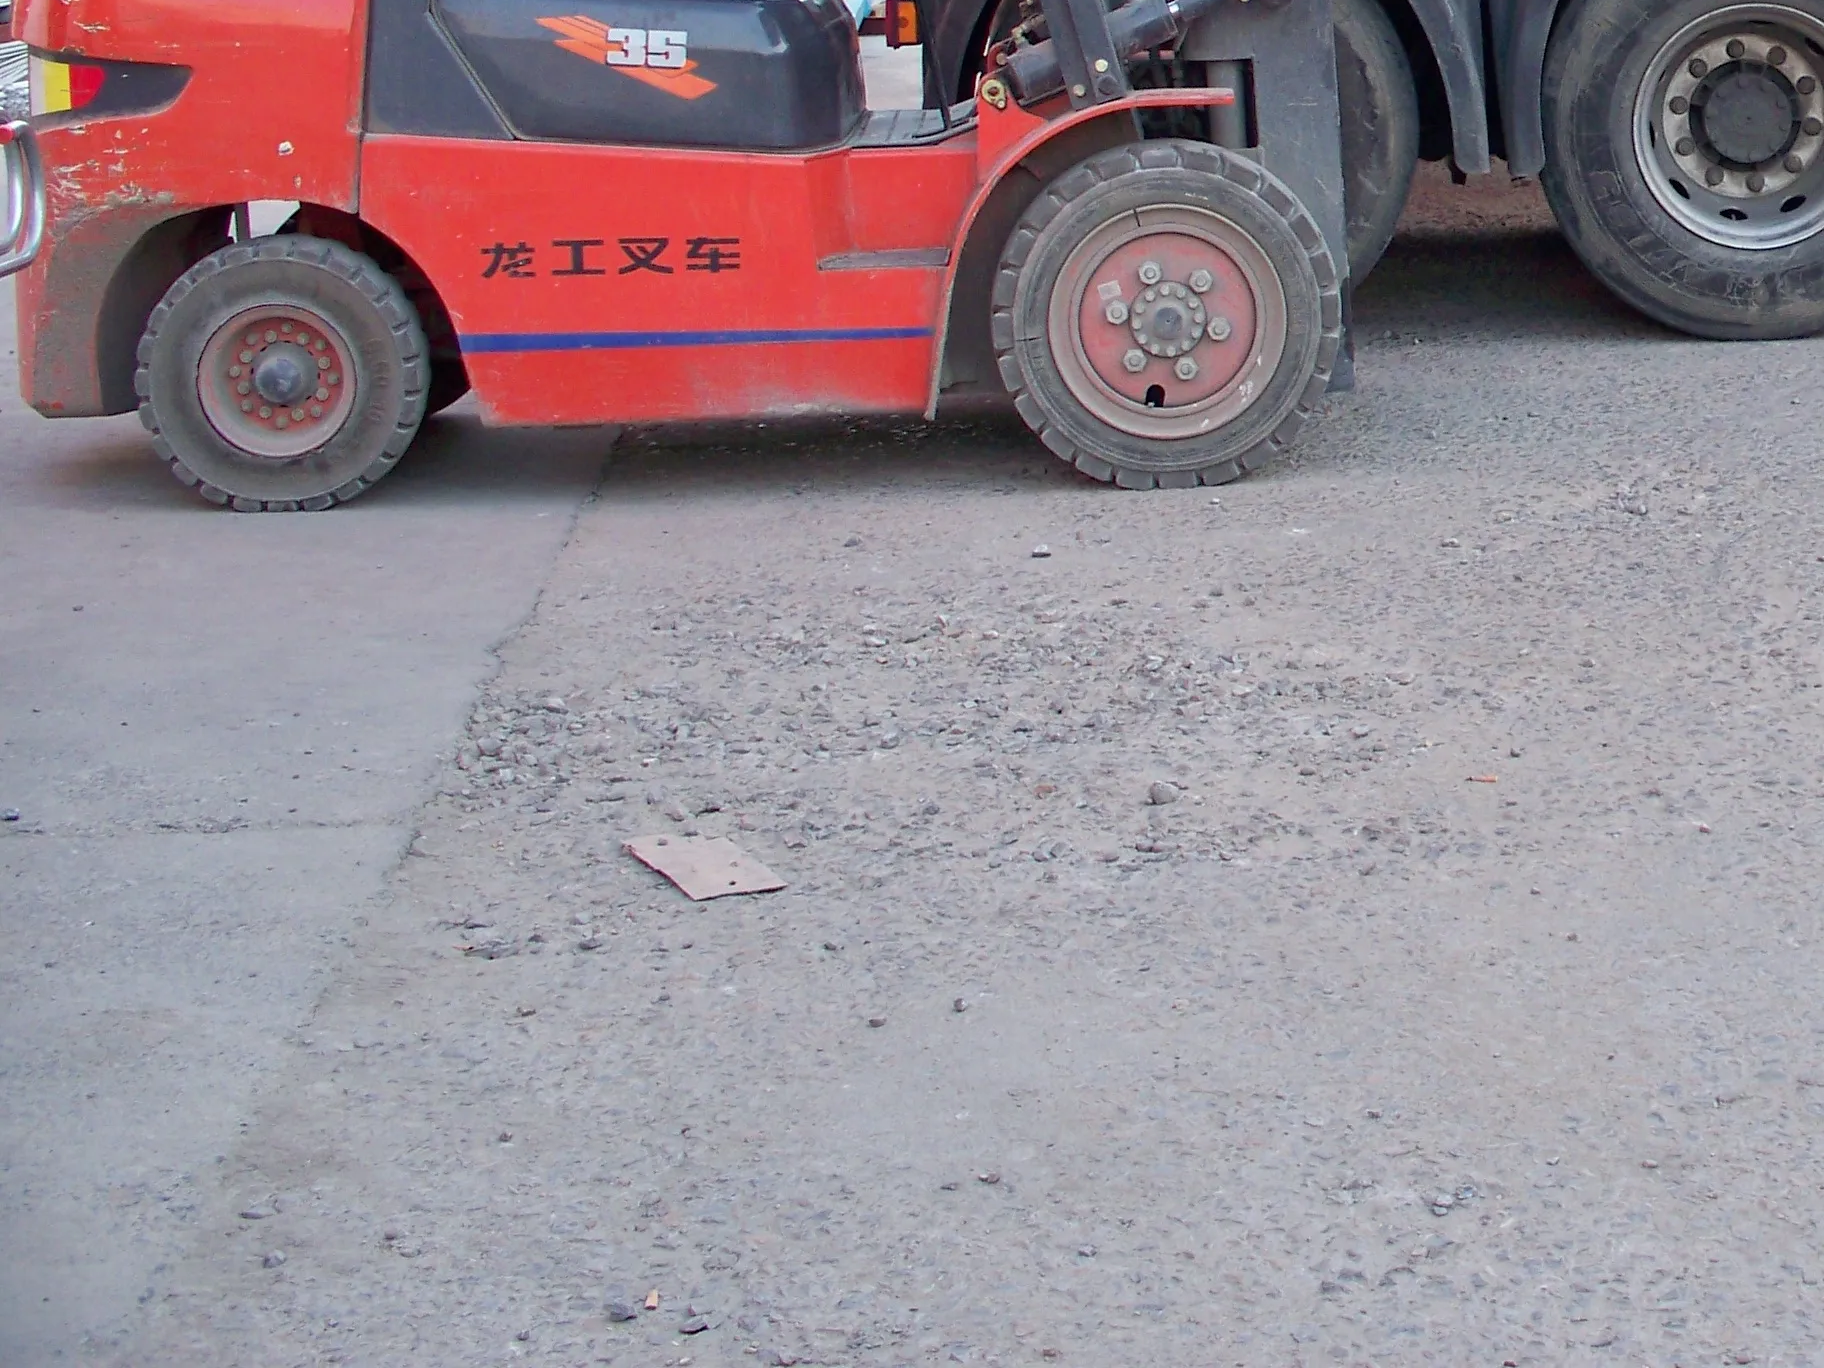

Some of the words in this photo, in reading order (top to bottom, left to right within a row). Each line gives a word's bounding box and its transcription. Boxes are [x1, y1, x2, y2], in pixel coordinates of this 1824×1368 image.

[606, 27, 688, 68] 35
[481, 237, 741, 279] 龙工叉车
